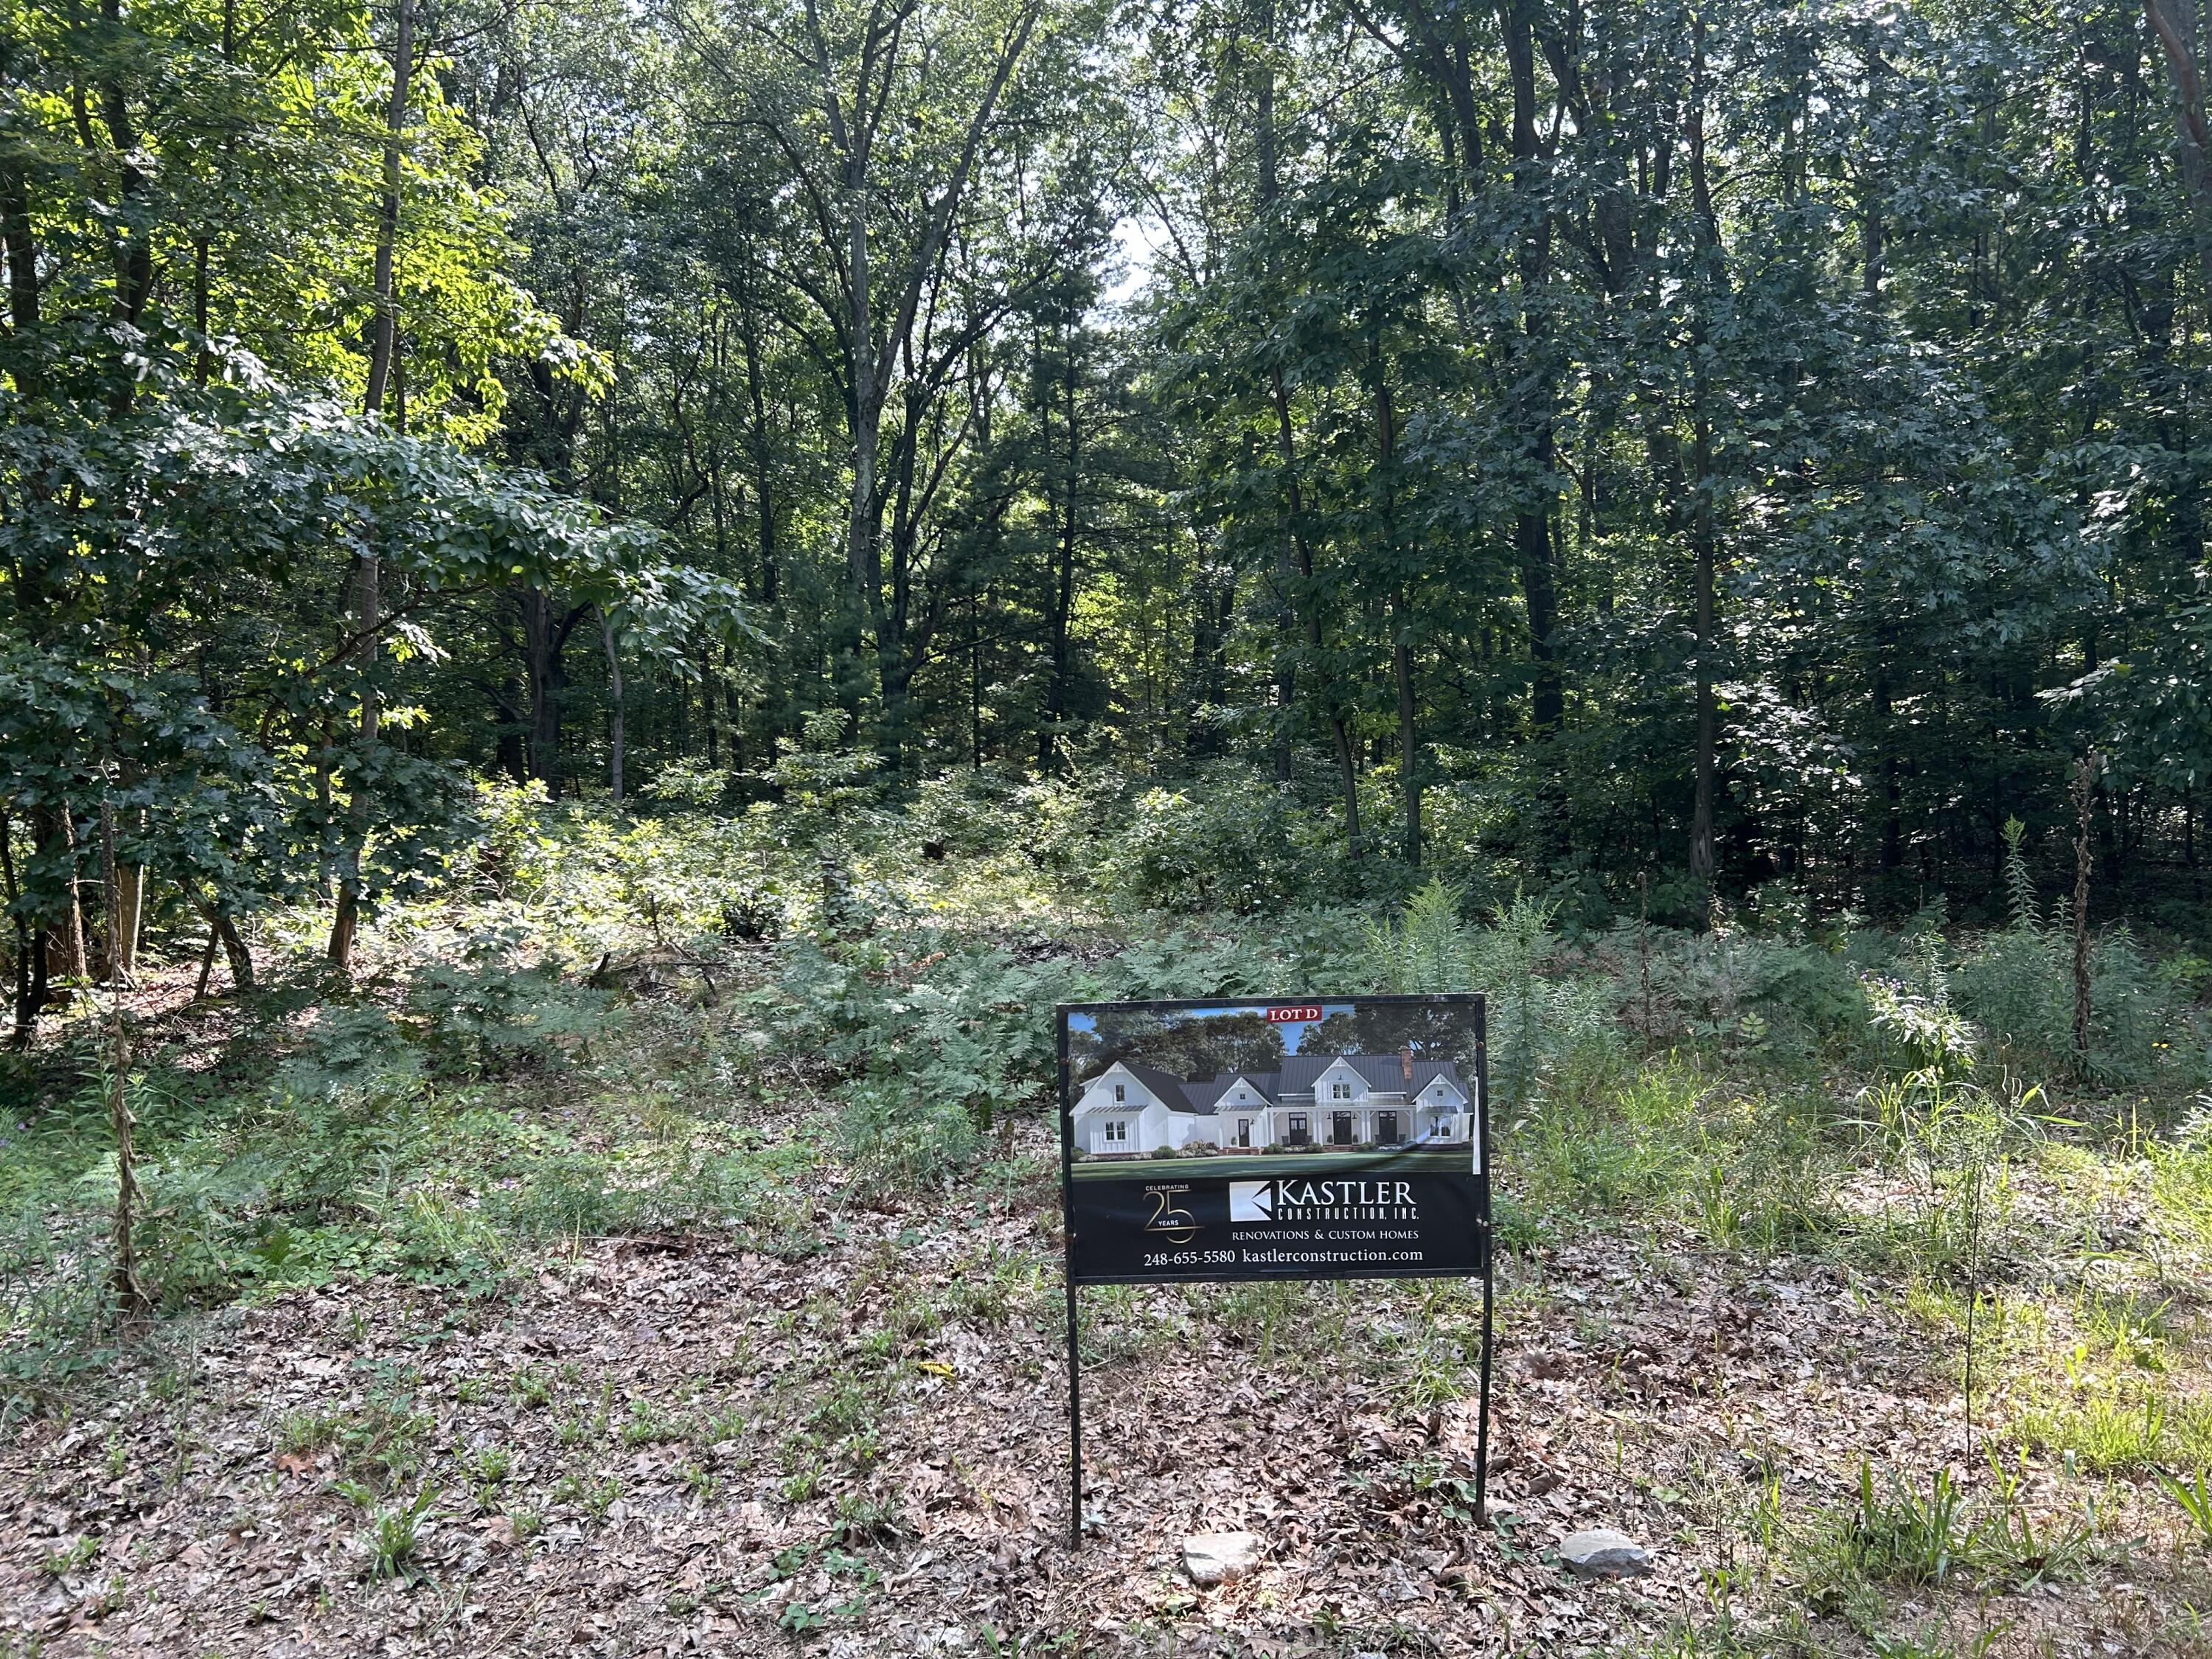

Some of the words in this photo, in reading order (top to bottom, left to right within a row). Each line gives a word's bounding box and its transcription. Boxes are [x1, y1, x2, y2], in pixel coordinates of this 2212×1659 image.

[1270, 1009, 1302, 1021] LOT
[1306, 1008, 1318, 1019] D
[1277, 1180, 1417, 1206] KASTLER
[1143, 1189, 1206, 1244] 25
[1394, 1206, 1419, 1220] INC.
[1232, 1231, 1310, 1240] RENOVATIONS
[1315, 1229, 1324, 1239] &
[1329, 1230, 1376, 1239] CUSTOM
[1380, 1230, 1419, 1239] HOMES
[1144, 1250, 1236, 1266] 248-655-5580
[1242, 1248, 1423, 1262] kastlerconstruction.com
